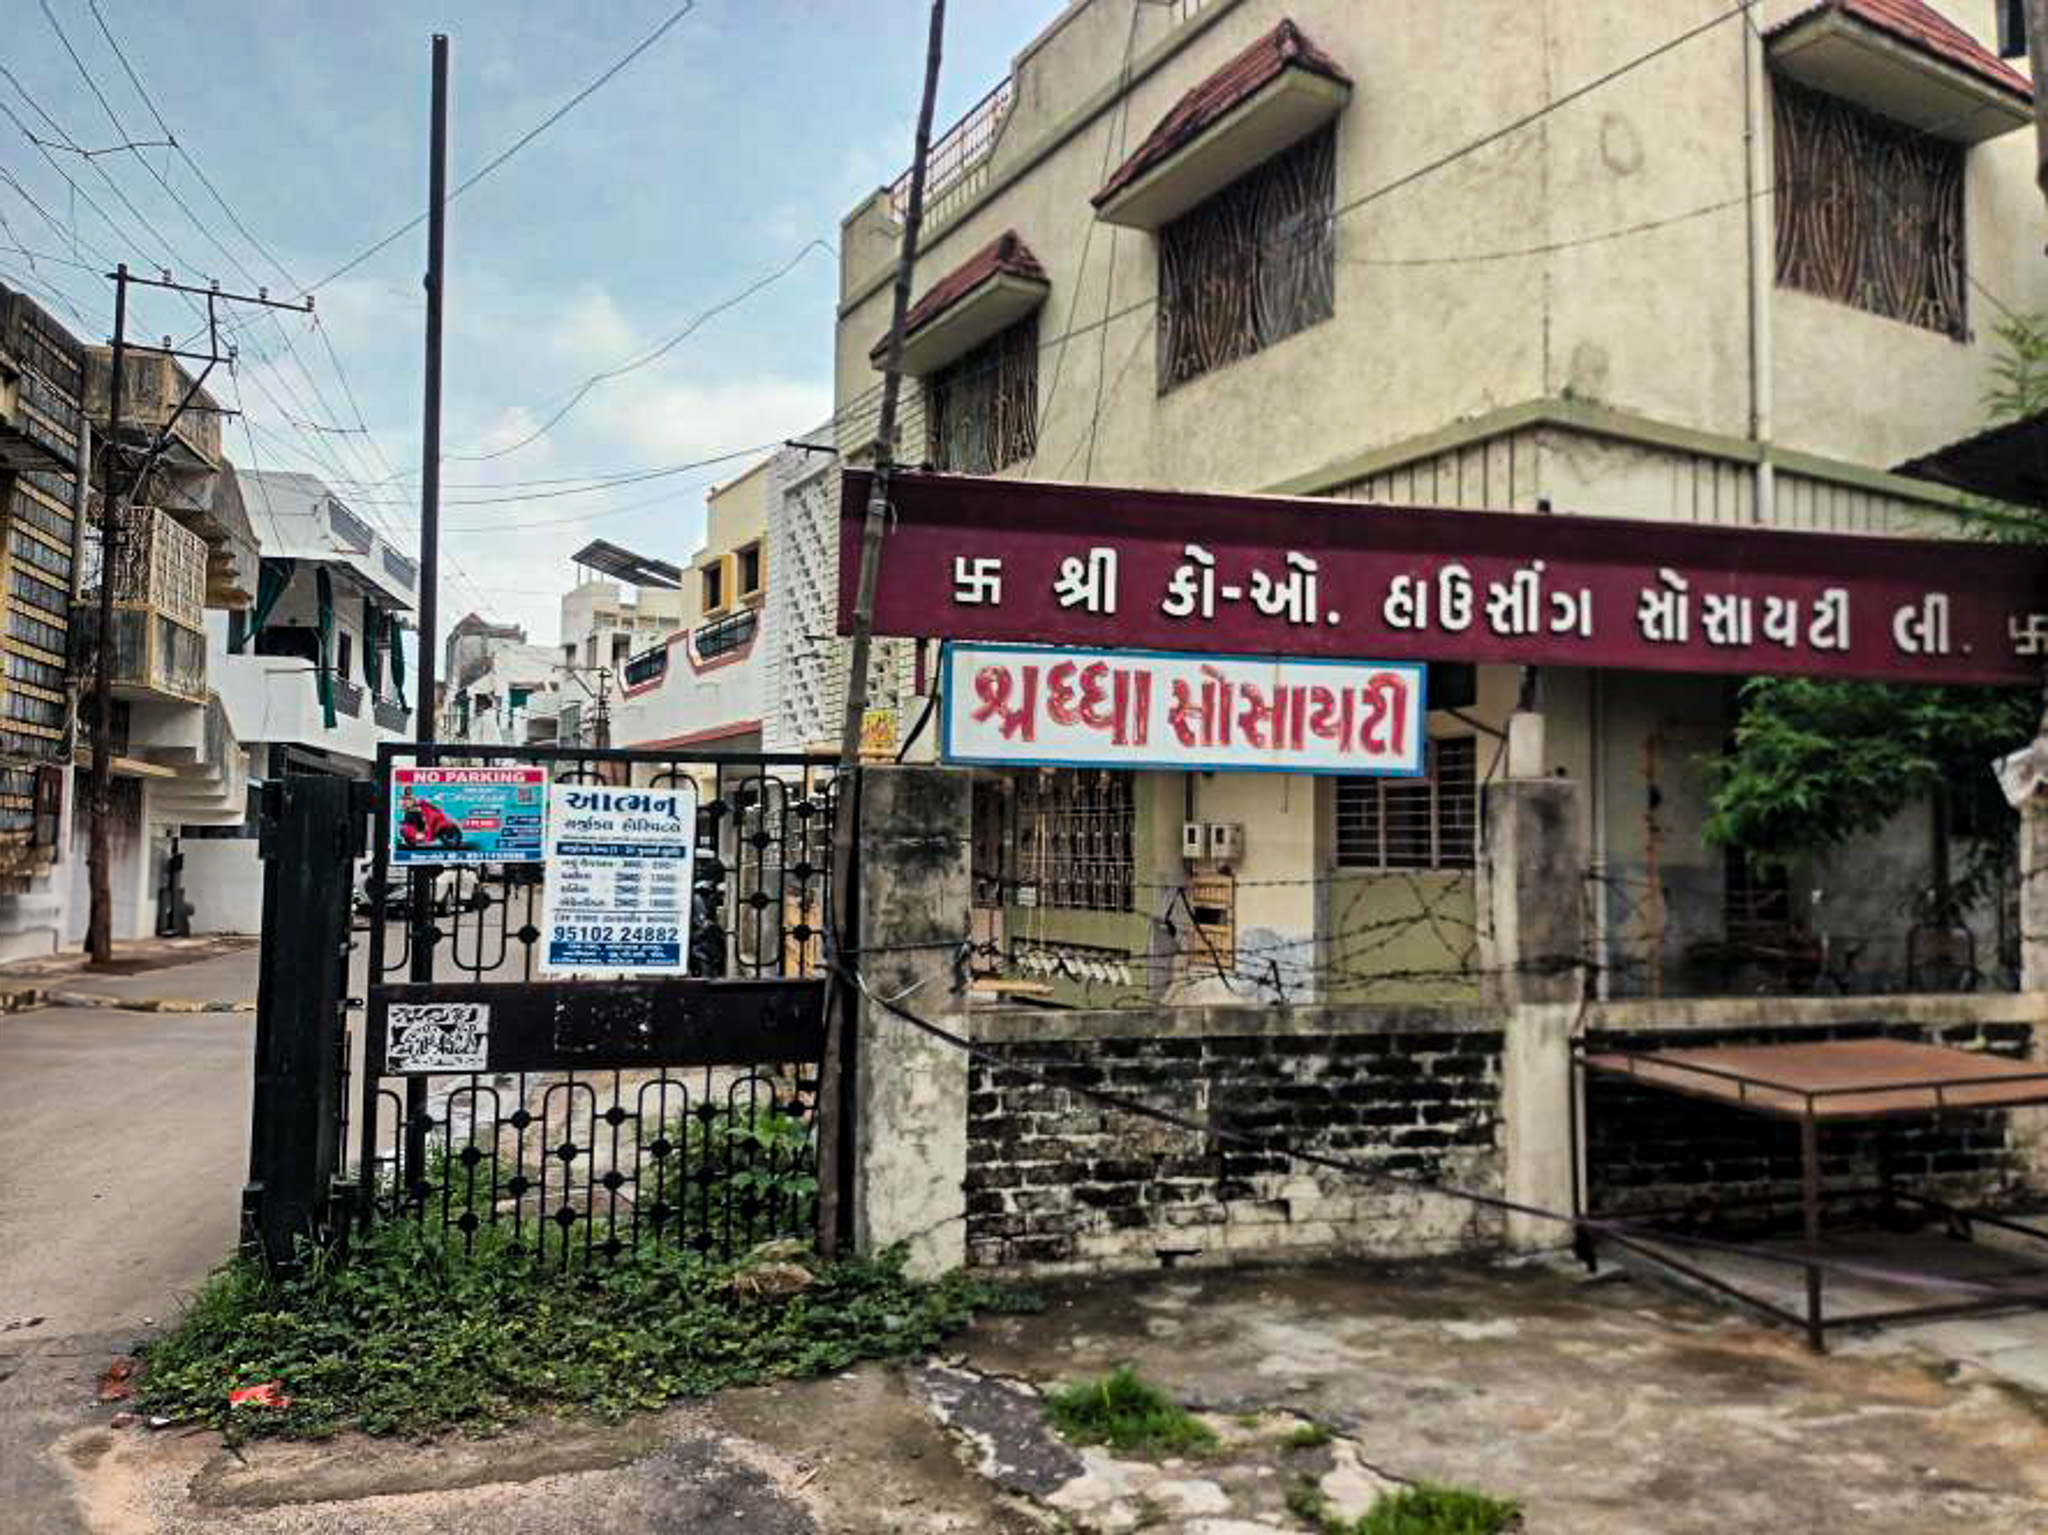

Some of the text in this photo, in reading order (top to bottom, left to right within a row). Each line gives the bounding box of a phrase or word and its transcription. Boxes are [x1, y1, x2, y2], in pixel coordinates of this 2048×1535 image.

[1053, 547, 1117, 614] શ્રી
[1382, 555, 1592, 636] હાઉસીંગ
[1638, 567, 1849, 649] સોસાયટી
[1168, 664, 1408, 757] સોસાયટી
[413, 771, 527, 783] NO PARKING
[554, 926, 679, 942] 95102 24882
